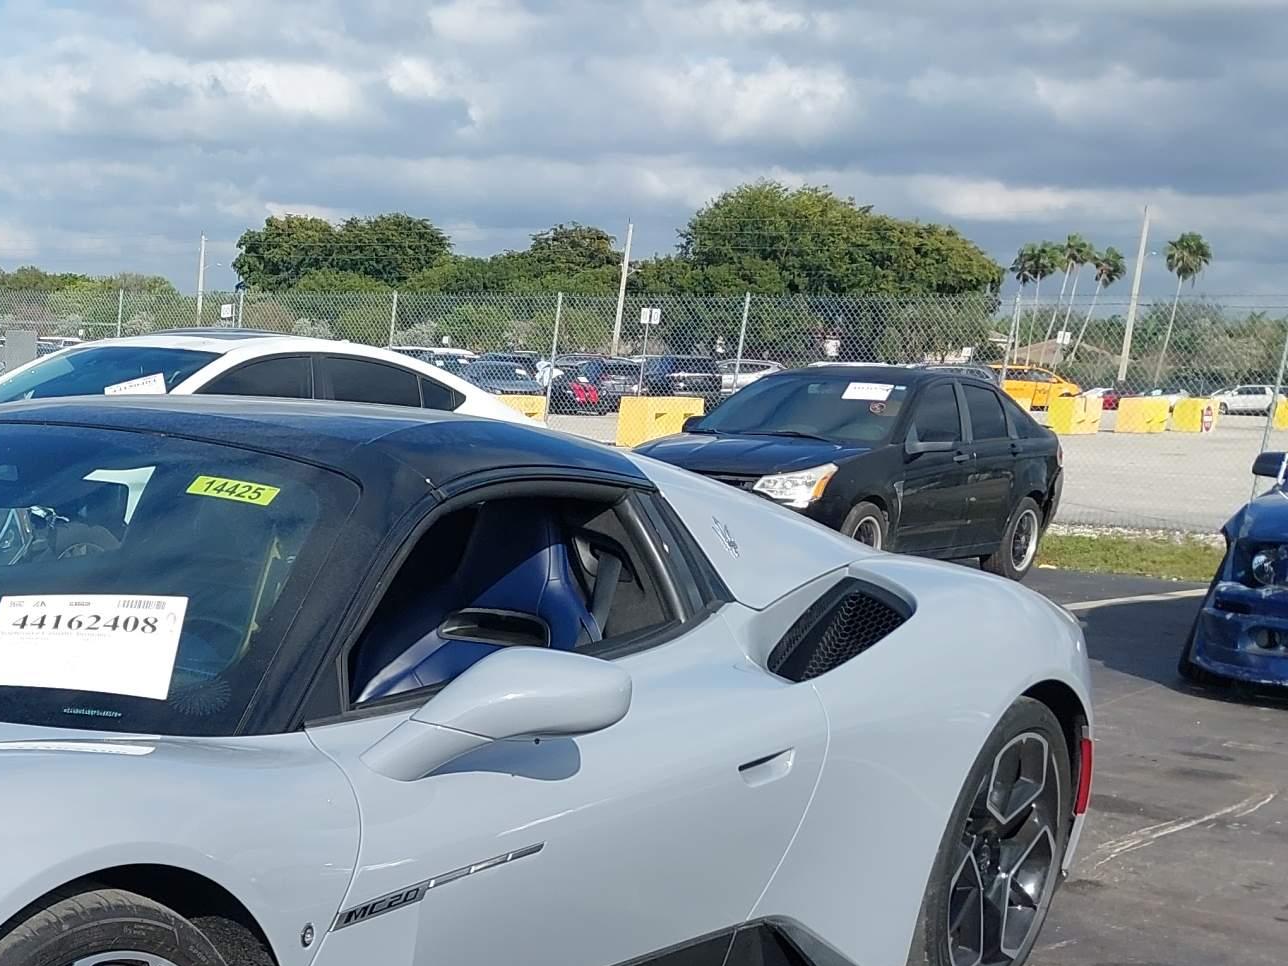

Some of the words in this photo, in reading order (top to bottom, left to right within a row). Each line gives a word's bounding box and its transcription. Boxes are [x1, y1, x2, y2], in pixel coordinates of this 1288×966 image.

[203, 479, 266, 501] 14425
[11, 613, 160, 634] 44162408
[344, 887, 420, 924] MC20
